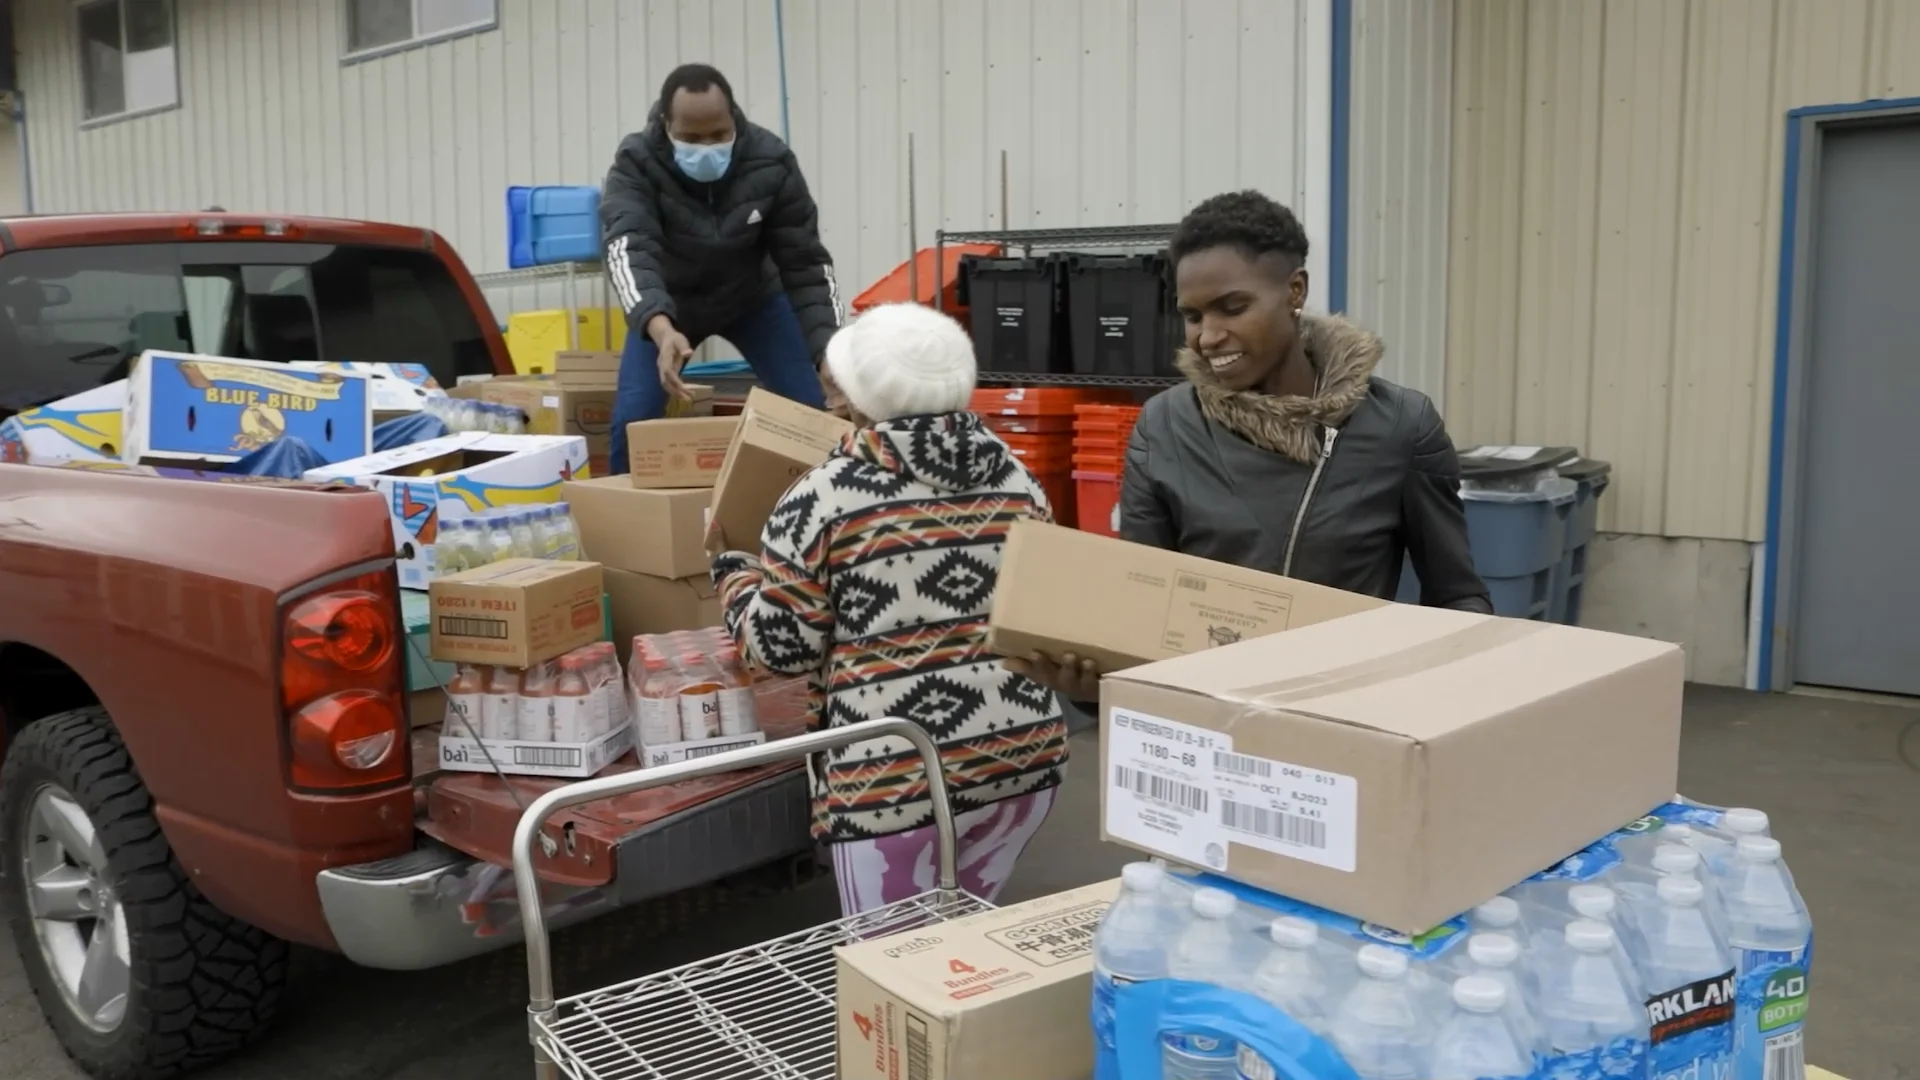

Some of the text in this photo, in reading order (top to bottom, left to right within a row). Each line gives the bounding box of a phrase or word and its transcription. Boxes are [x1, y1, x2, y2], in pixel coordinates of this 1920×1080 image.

[206, 387, 318, 412] BLUE BIRD
[481, 599, 517, 612] ITEM
[702, 701, 718, 715] ba
[443, 744, 469, 763] bai
[1260, 784, 1281, 795] OCT
[943, 966, 1010, 989] Bundles
[947, 958, 977, 975] 4
[1765, 976, 1805, 998] 40
[1647, 976, 1735, 1026] RKLAN
[852, 1010, 874, 1042] 4
[874, 1003, 886, 1073] Bundles
